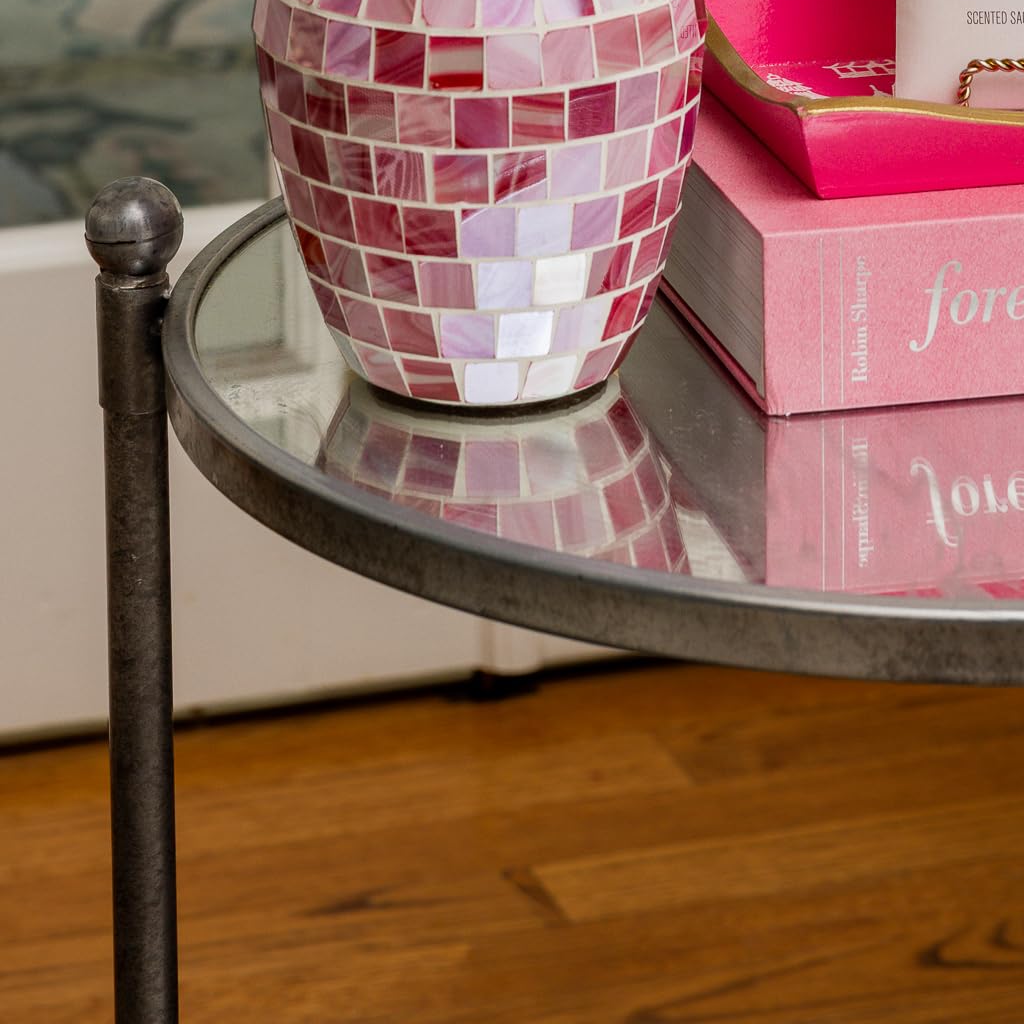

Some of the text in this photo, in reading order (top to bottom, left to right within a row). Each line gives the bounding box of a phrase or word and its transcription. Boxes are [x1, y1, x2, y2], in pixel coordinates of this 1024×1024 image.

[966, 10, 1008, 25] SCENTED
[850, 255, 873, 383] Robin Sharpe
